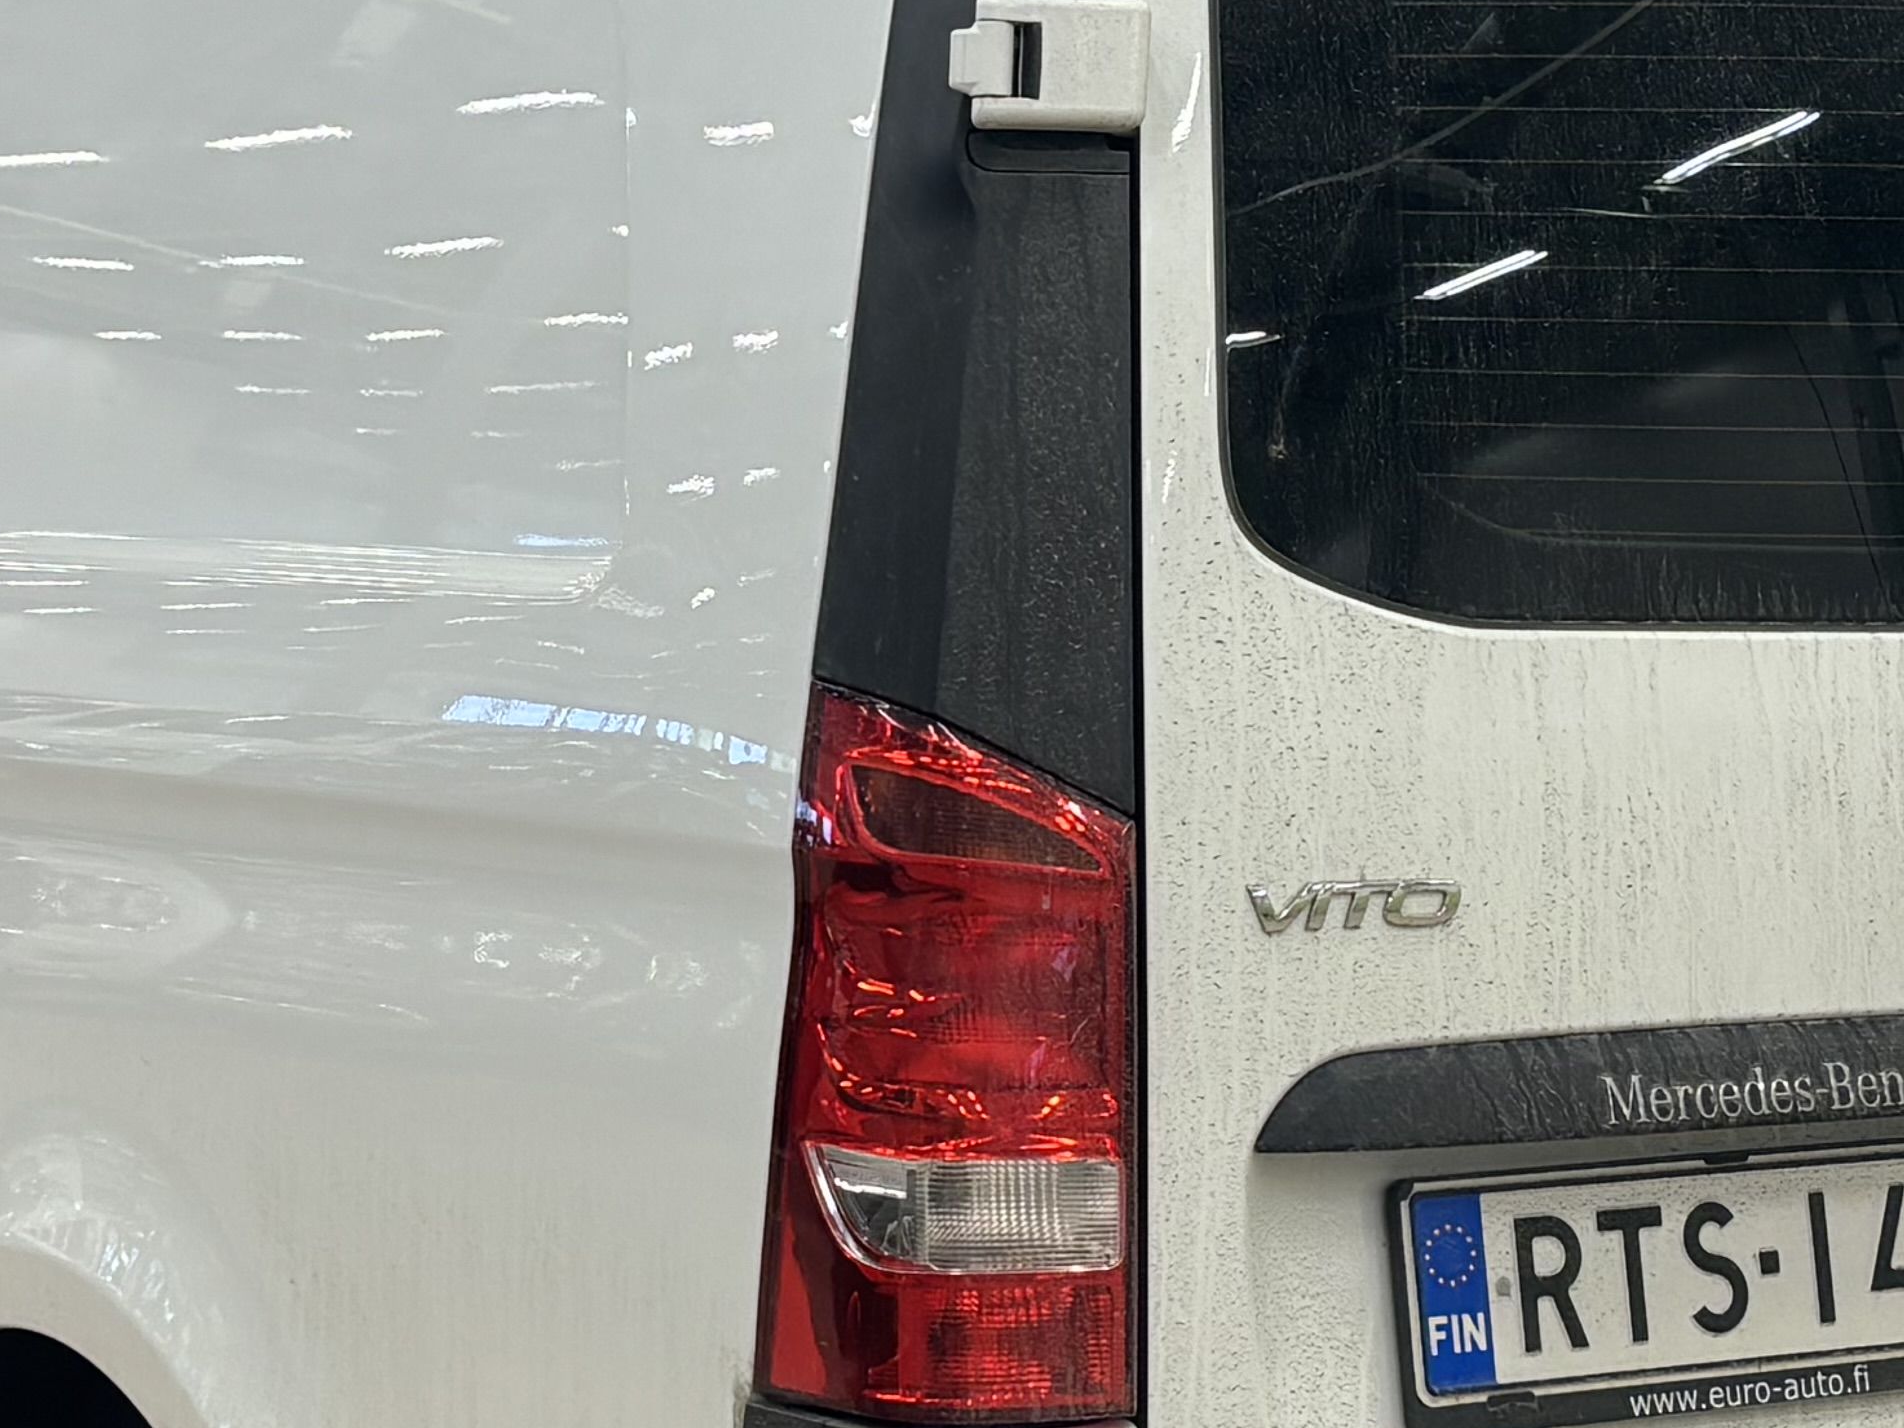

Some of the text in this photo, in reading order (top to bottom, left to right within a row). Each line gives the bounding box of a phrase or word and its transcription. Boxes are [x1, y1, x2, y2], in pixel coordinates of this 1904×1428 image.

[1246, 879, 1461, 935] VITO
[1427, 1312, 1488, 1357] FIN
[1629, 1364, 1871, 1418] www.euro-auto.fi
